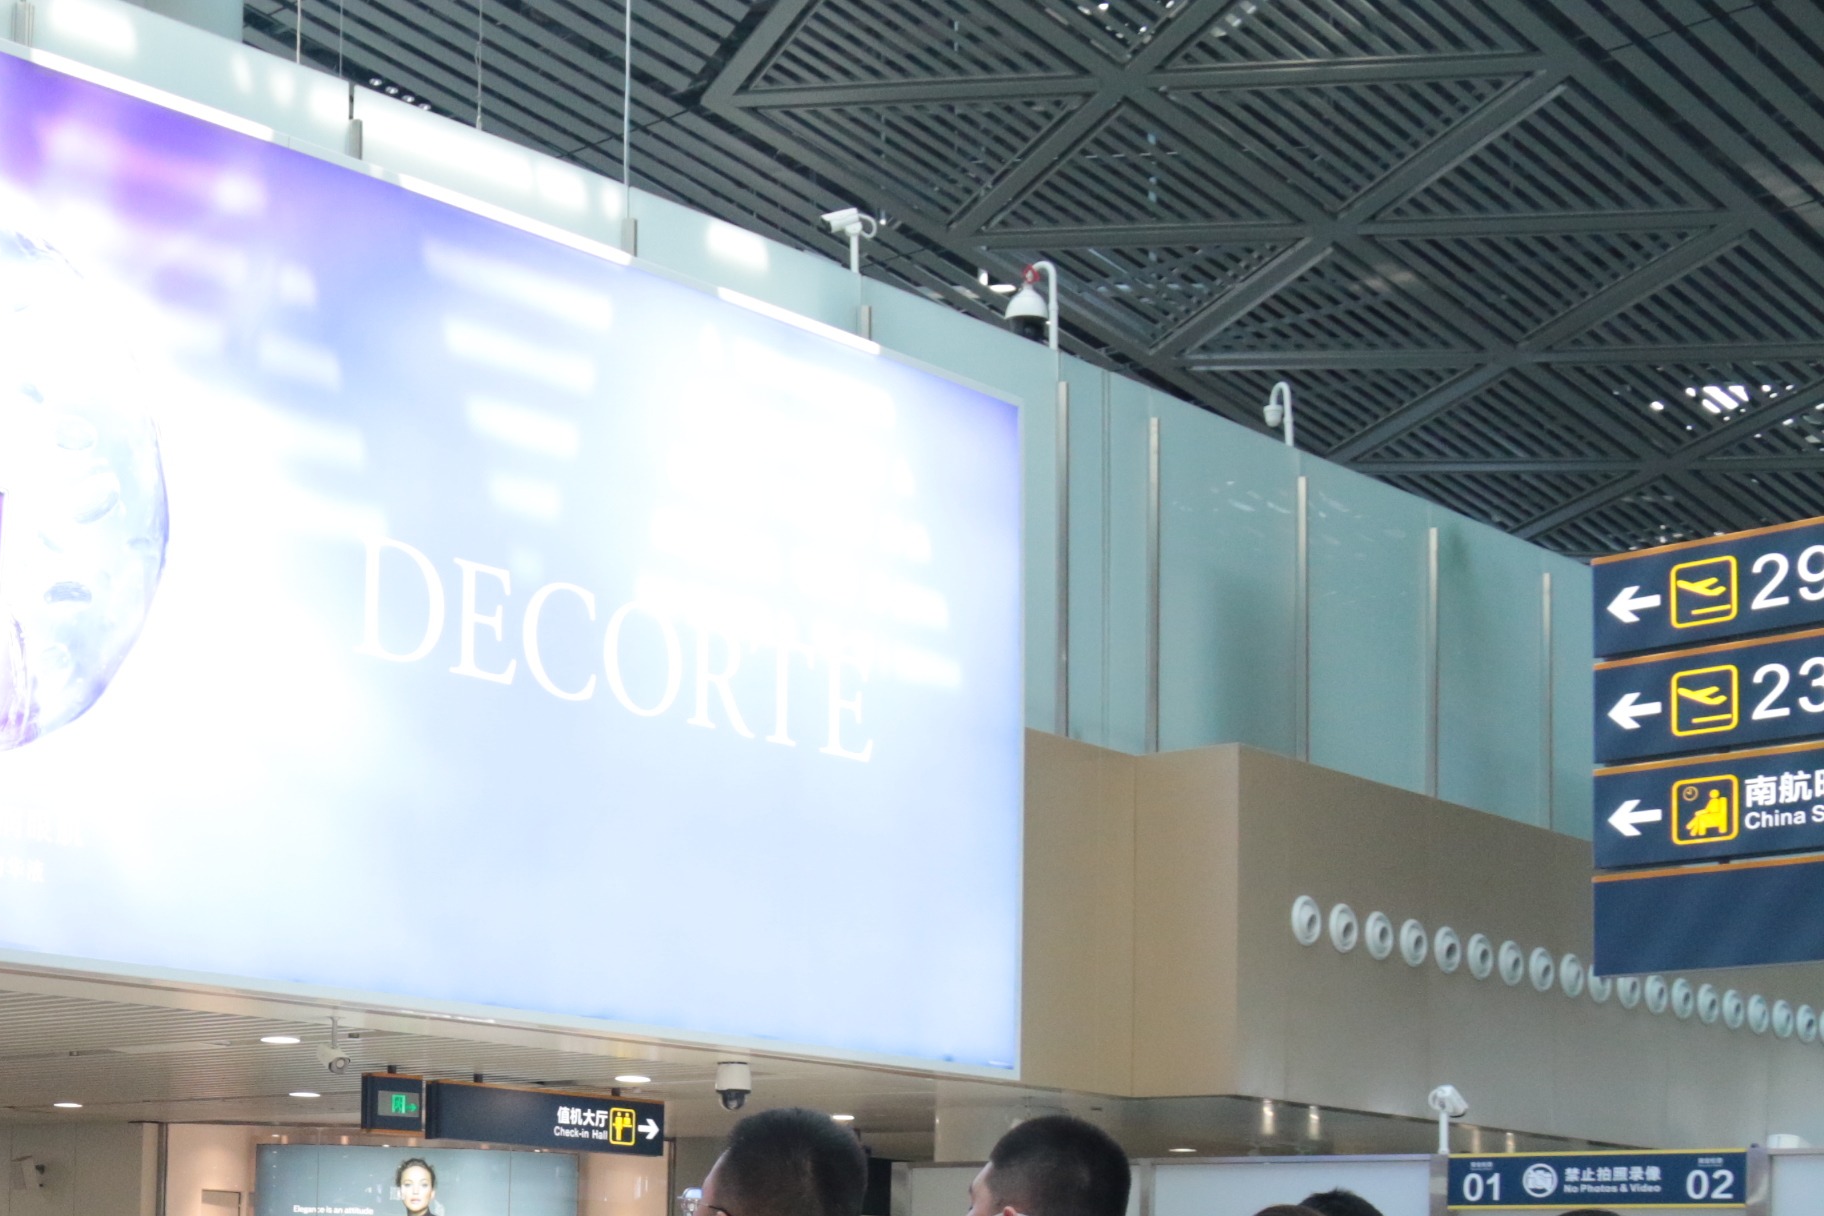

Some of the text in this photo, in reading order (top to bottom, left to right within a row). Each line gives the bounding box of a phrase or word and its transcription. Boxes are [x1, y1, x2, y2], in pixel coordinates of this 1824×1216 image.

[1745, 810, 1806, 829] China
[557, 1106, 608, 1127] 值机大厅
[554, 1126, 608, 1140] Check-in Hall
[1564, 1166, 1662, 1182] 禁止拍照录像
[1463, 1173, 1501, 1201] 01
[1564, 1183, 1662, 1193] No Photos & Video
[1686, 1169, 1735, 1200] 02
